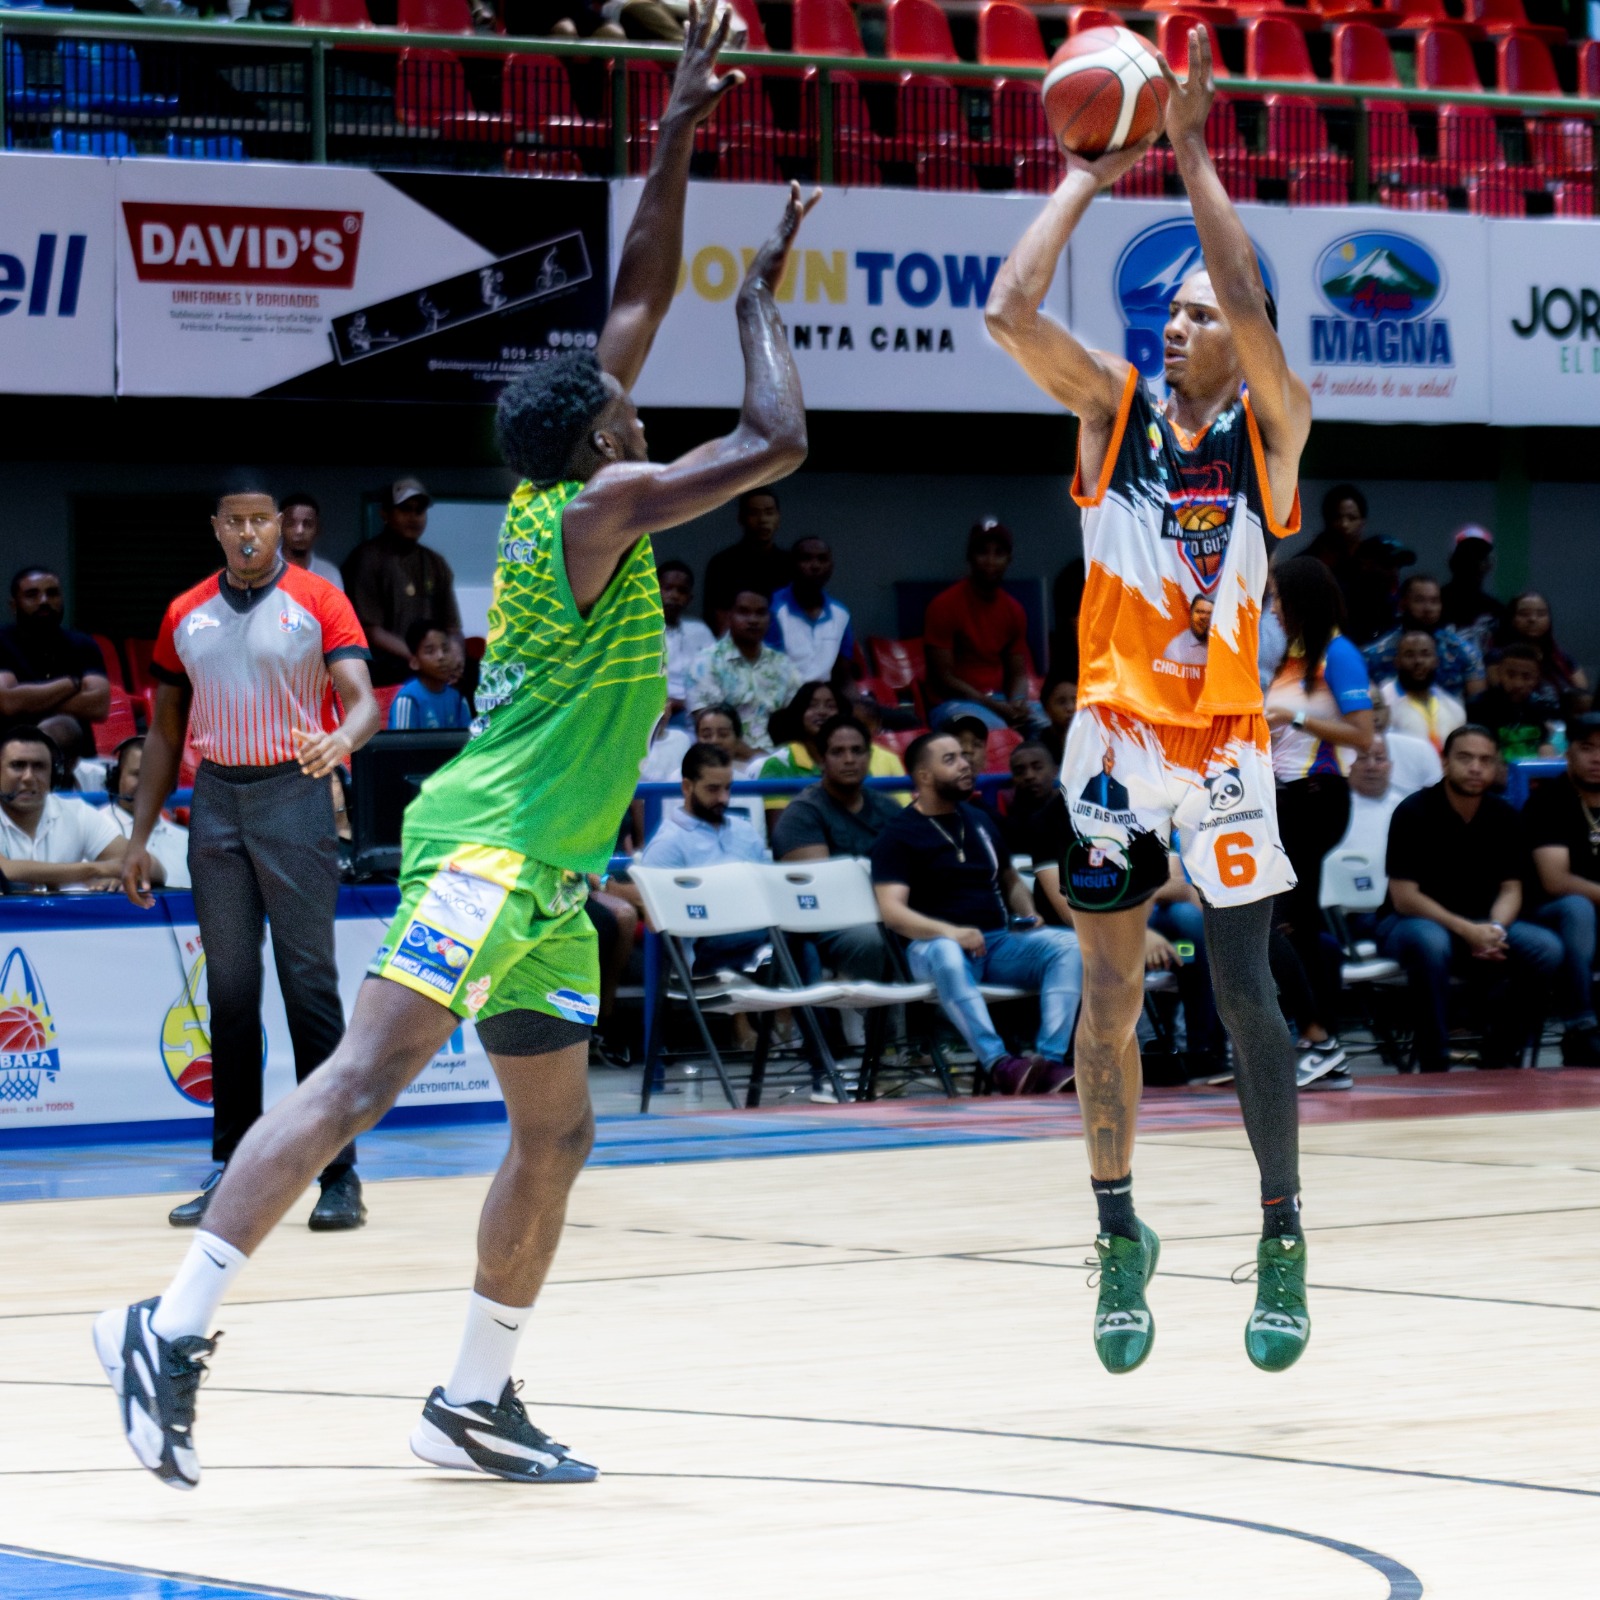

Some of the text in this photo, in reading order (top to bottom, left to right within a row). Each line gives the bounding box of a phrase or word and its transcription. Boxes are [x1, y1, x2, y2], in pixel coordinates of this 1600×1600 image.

[141, 221, 345, 272] DAVID'S
[171, 290, 242, 307] UNIFORMES
[245, 291, 254, 307] Y
[784, 324, 955, 353] NTA CANA
[1311, 318, 1454, 366] MAGNA
[1560, 345, 1583, 374] EL
[1072, 802, 1138, 825] LUIS BASTARDO
[1213, 831, 1258, 889] 6
[431, 1059, 467, 1074] imagen
[401, 1079, 490, 1095] IGUEYDIGITAL.COM
[45, 1102, 75, 1112] TODOS
